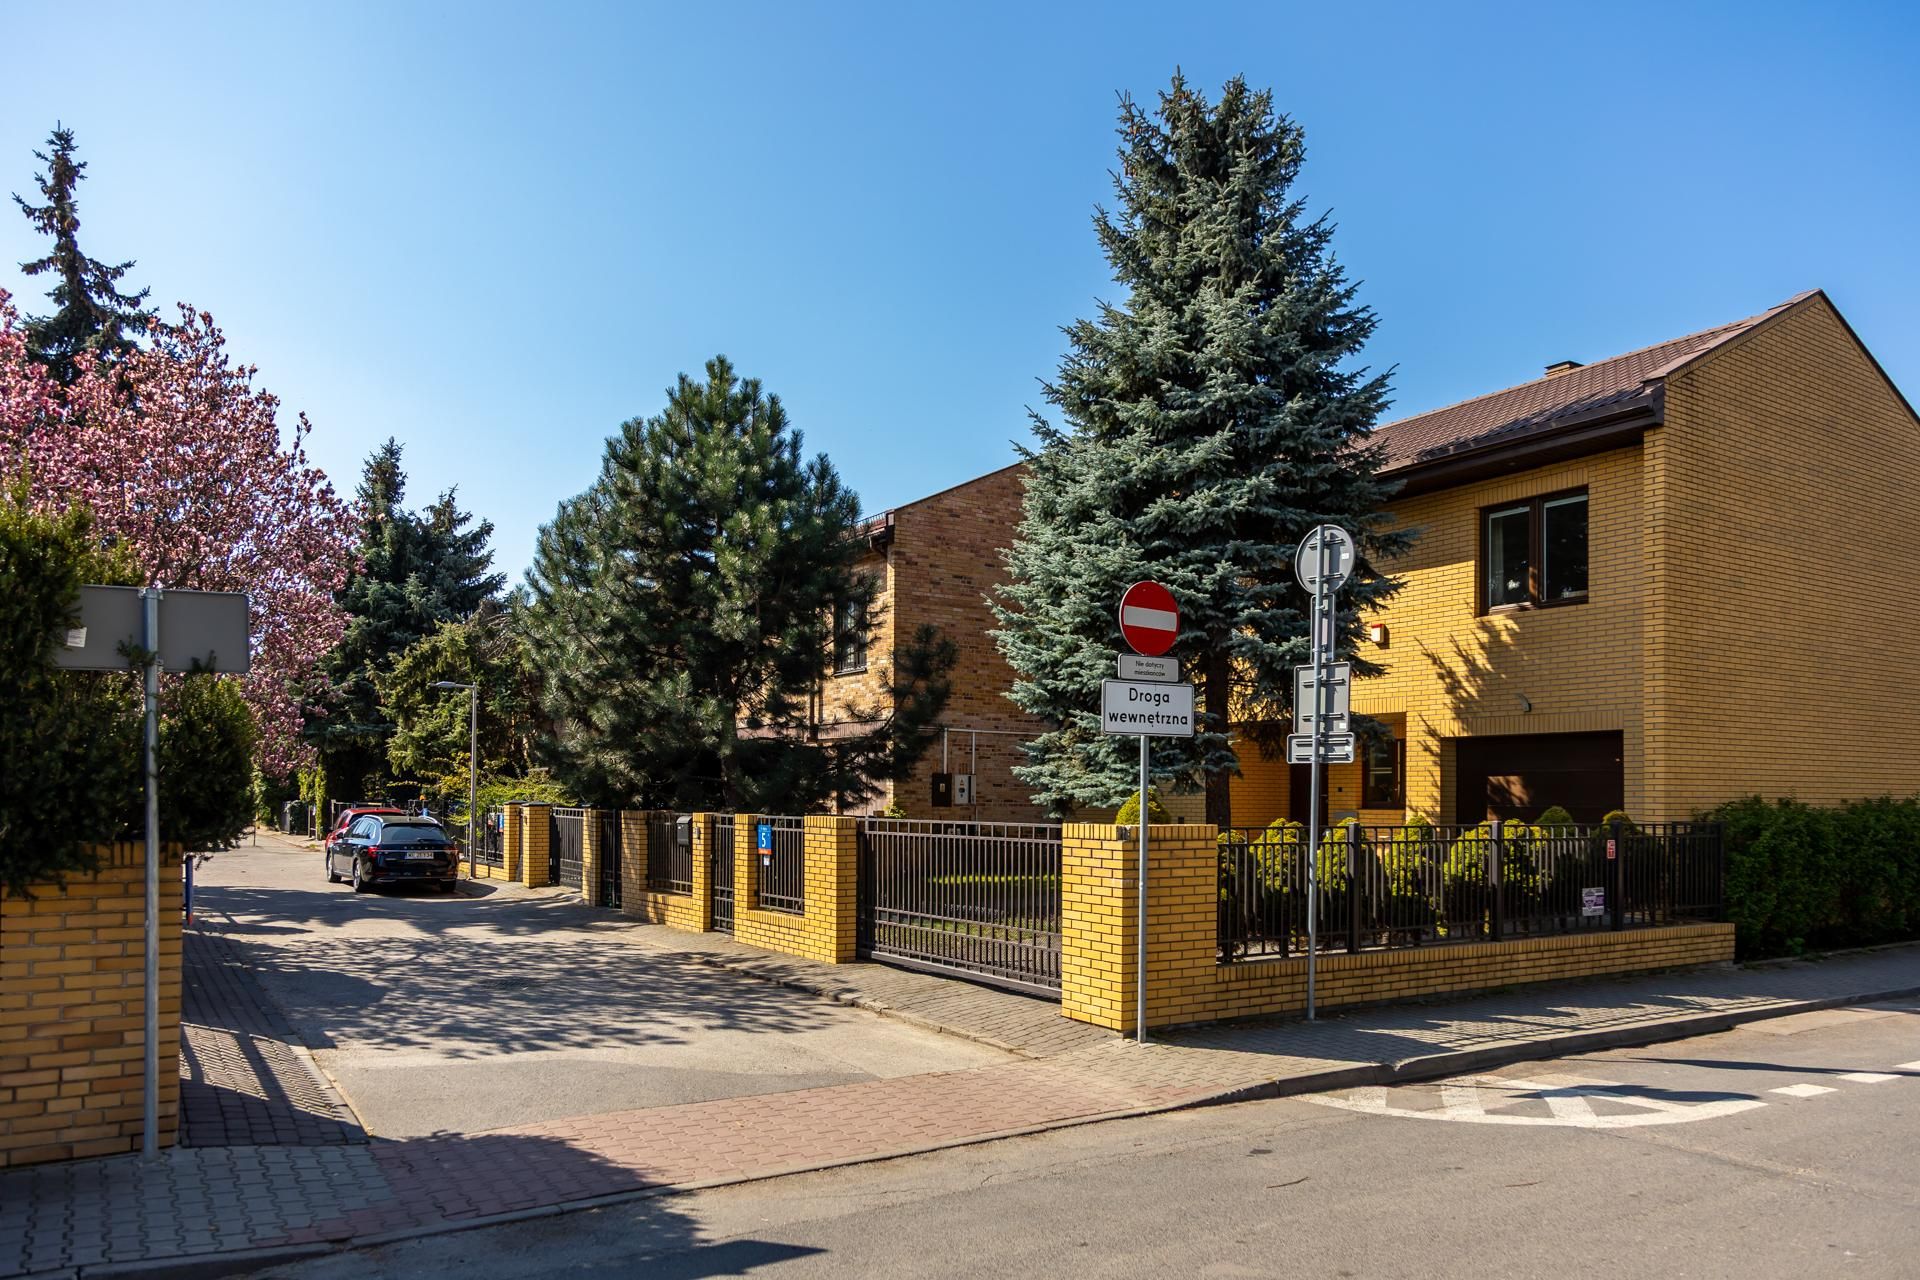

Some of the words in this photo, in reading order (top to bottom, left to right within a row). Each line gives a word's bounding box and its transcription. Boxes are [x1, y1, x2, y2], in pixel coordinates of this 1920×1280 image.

[1145, 661, 1164, 670] dotyczy
[1129, 687, 1169, 706] Droga
[1109, 711, 1188, 726] wewnętrzna
[761, 832, 766, 847] 5
